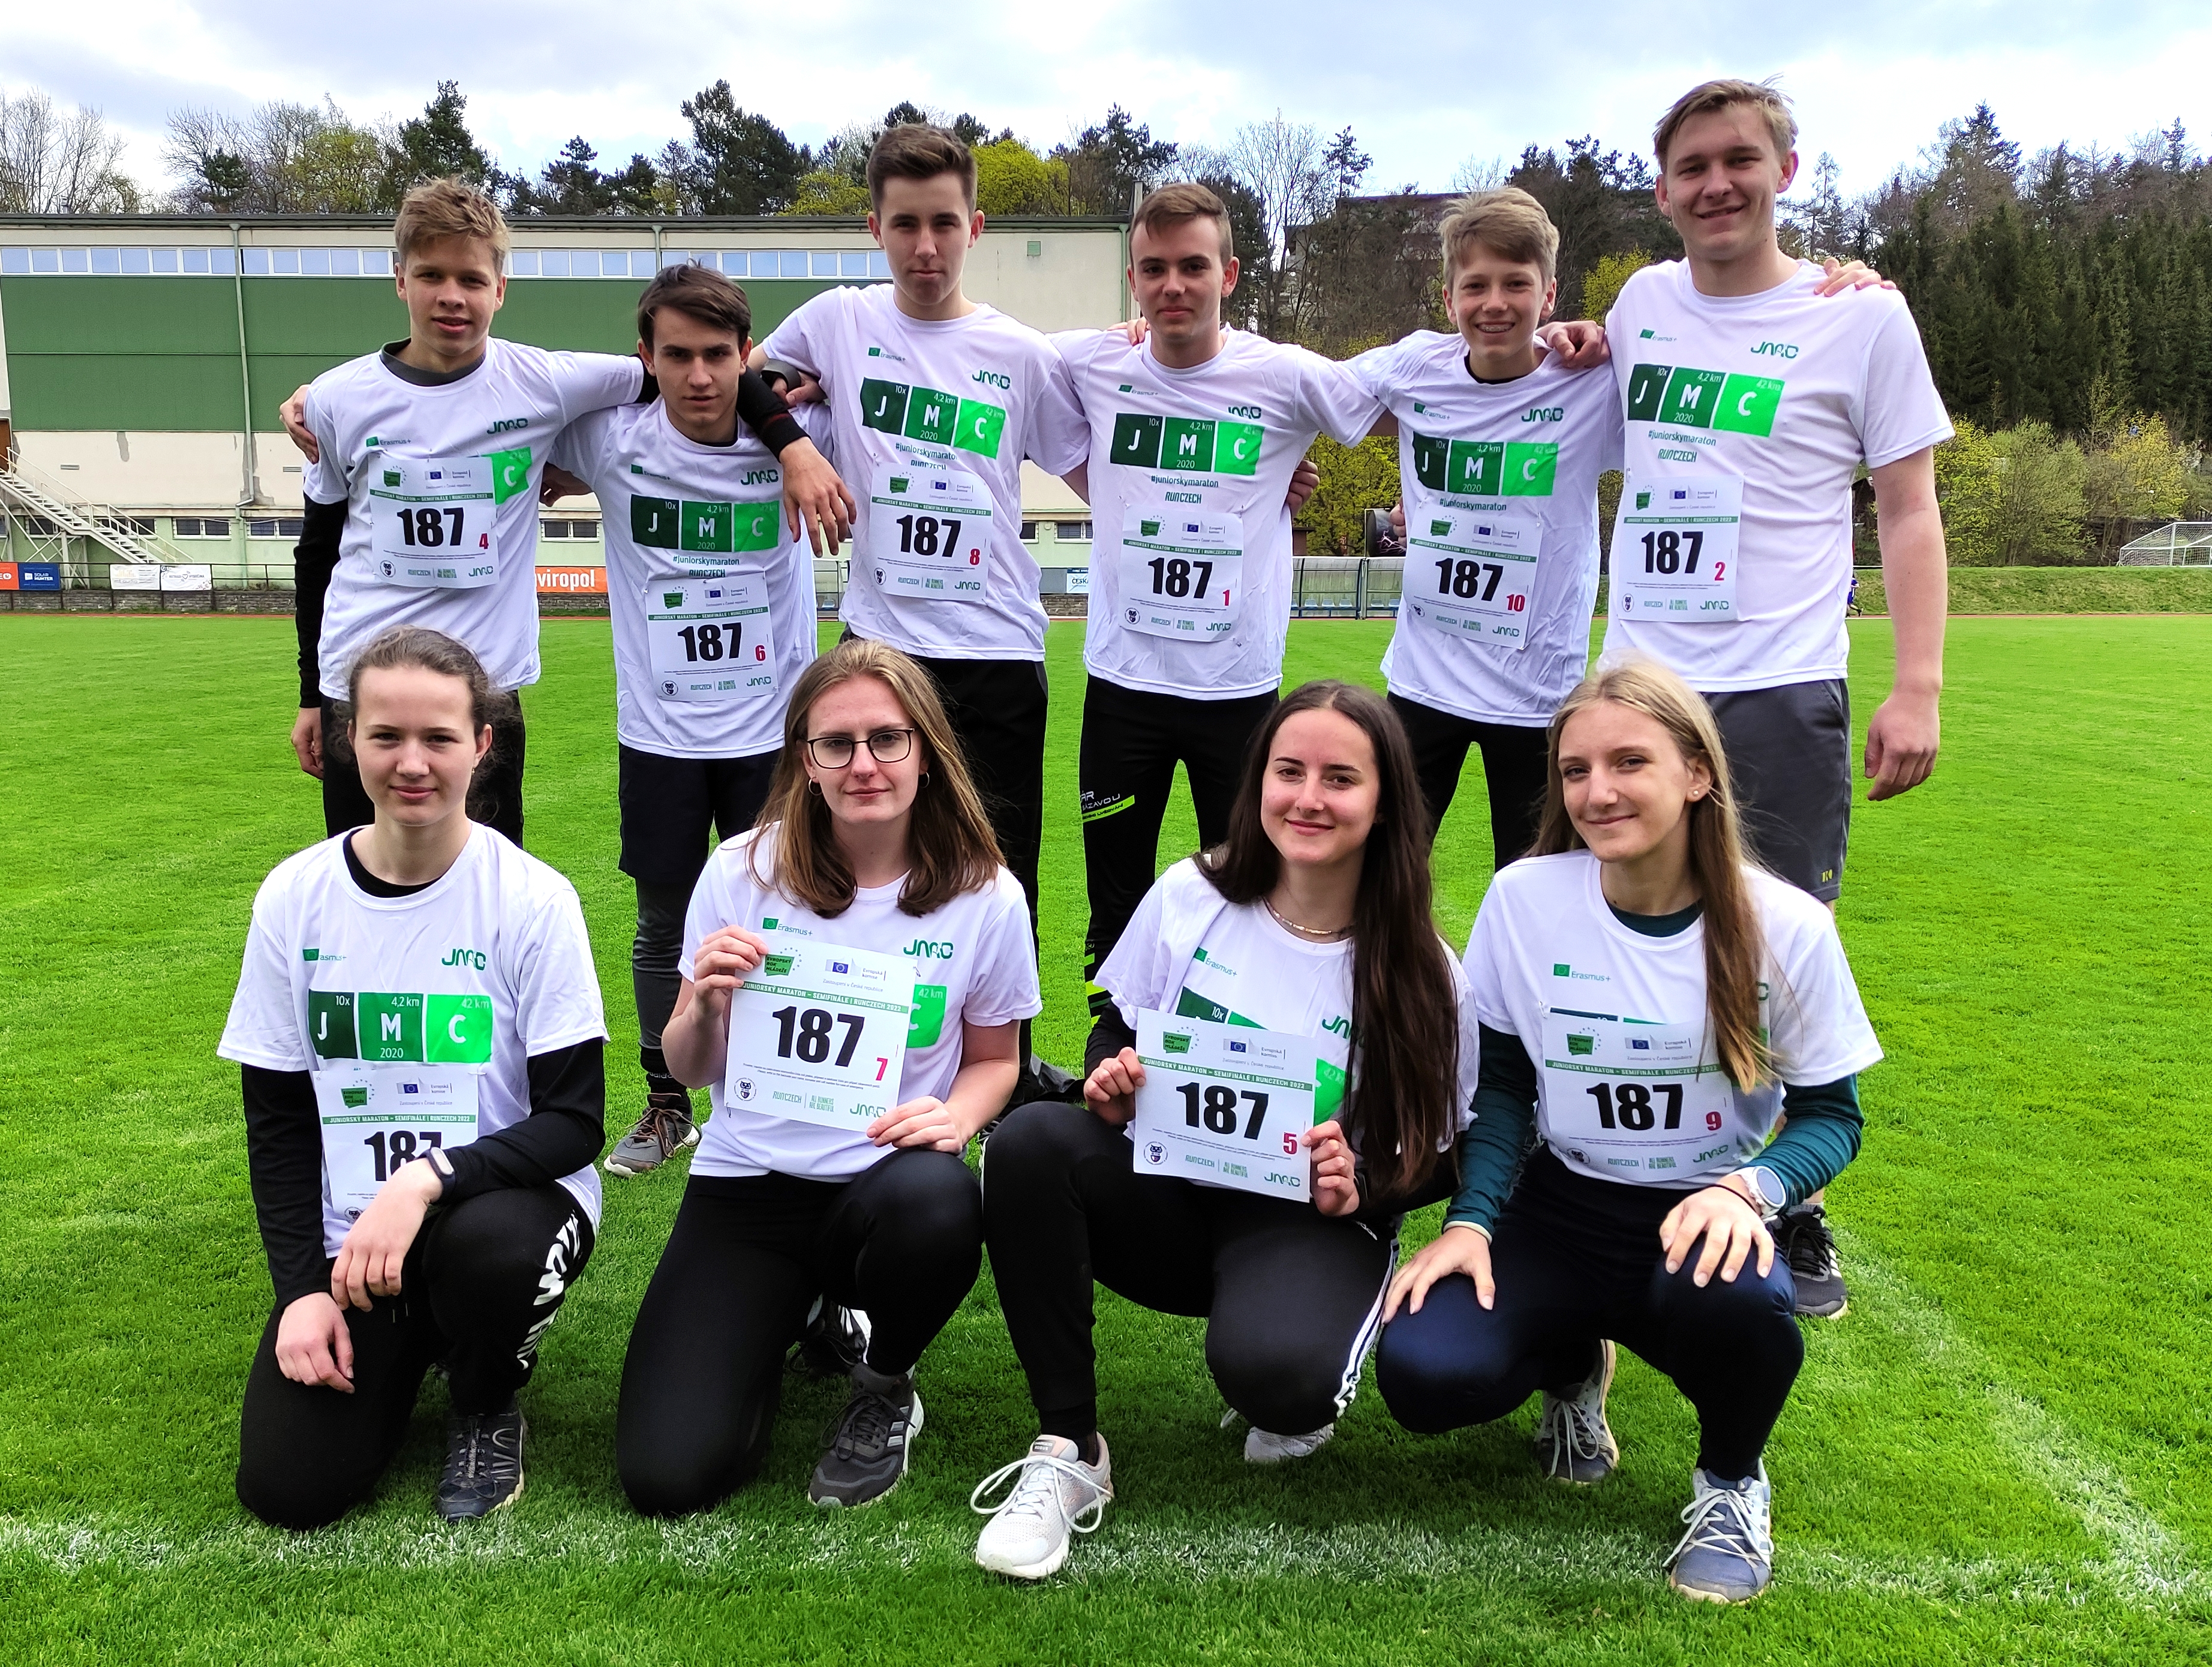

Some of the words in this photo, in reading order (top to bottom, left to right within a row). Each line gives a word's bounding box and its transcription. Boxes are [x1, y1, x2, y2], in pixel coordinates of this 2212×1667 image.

[1657, 368, 1667, 376] 10x
[1697, 373, 1709, 383] 4,2
[1710, 374, 1721, 383] km
[895, 385, 906, 395] 10x
[1757, 380, 1766, 389] 42
[934, 392, 944, 403] 4,2
[945, 396, 955, 405] km
[1635, 380, 1648, 404] J
[1679, 384, 1702, 409] M
[1738, 392, 1757, 417] C
[874, 396, 887, 416] J
[924, 404, 940, 428] M
[975, 417, 987, 440] C
[1149, 418, 1159, 426] 10x
[1424, 410, 1450, 420] Erasmus+
[1673, 413, 1694, 423] 2020
[1190, 422, 1201, 430] 4,2
[1202, 423, 1213, 431] km
[920, 430, 938, 441] 2020
[1648, 429, 1716, 446] #juniorskymaraton
[895, 442, 958, 460] #juniorskymarato
[1128, 429, 1140, 450] J
[1179, 434, 1197, 455] M
[1234, 438, 1246, 460] C
[1436, 440, 1446, 449] 10x
[1176, 459, 1195, 468] 2020
[1658, 449, 1697, 462] RUNCZECH
[1422, 450, 1429, 472] J
[1465, 456, 1484, 479] M
[1522, 458, 1537, 480] C
[504, 465, 516, 488] C
[1151, 475, 1219, 488] #juniorskymaraton
[1463, 483, 1481, 492] 2020
[665, 501, 676, 510] 10x
[1165, 491, 1202, 504] RUNCZECH
[1440, 498, 1506, 511] #juniorskymaraton
[397, 507, 464, 546] 187
[648, 512, 658, 533] J
[699, 516, 715, 537] M
[752, 517, 764, 537] C
[479, 533, 489, 549] 4
[897, 515, 961, 557] 187
[698, 542, 715, 550] 2020
[1642, 531, 1703, 574] 187
[673, 555, 739, 566] #juniorskymaraton
[970, 549, 980, 565] 8
[1148, 557, 1213, 599] 187
[1715, 562, 1726, 581] 2
[535, 569, 595, 591] viropol
[1435, 558, 1504, 602] 187
[1223, 590, 1230, 606] 1
[1507, 594, 1525, 612] 10
[678, 622, 741, 662] 187
[755, 645, 765, 662] 6
[778, 924, 813, 936] Erasmus+
[1206, 959, 1237, 977] Erasmus+
[1571, 971, 1611, 981] Erasmus+
[335, 995, 350, 1006] 10x
[743, 982, 776, 992] JUNIORSKÝ
[777, 987, 806, 997] MARATON
[813, 992, 849, 1004] SEMIFINÁLE
[854, 999, 885, 1009] RUNCZECH
[918, 989, 928, 998] 42
[931, 989, 943, 998] km
[392, 997, 405, 1008] 4,2
[407, 997, 419, 1007] km
[461, 998, 472, 1008] 42
[474, 999, 489, 1008] km
[1212, 1006, 1224, 1020] 10x
[317, 1012, 327, 1040] J
[381, 1013, 401, 1041] M
[448, 1014, 467, 1043] C
[772, 1006, 865, 1068] 187
[380, 1048, 403, 1058] 2020
[876, 1058, 888, 1081] 7
[1143, 1058, 1177, 1069] JUNIORSKÝ
[1179, 1065, 1207, 1074] MARATON
[1257, 1076, 1288, 1086] RUNCZECH
[773, 1091, 801, 1103] RUNCZECH
[1176, 1082, 1269, 1140] 187
[1586, 1082, 1683, 1131] 187
[1706, 1111, 1722, 1131] 9
[1283, 1132, 1297, 1154] 5
[1185, 1155, 1215, 1167] RUNCZECH
